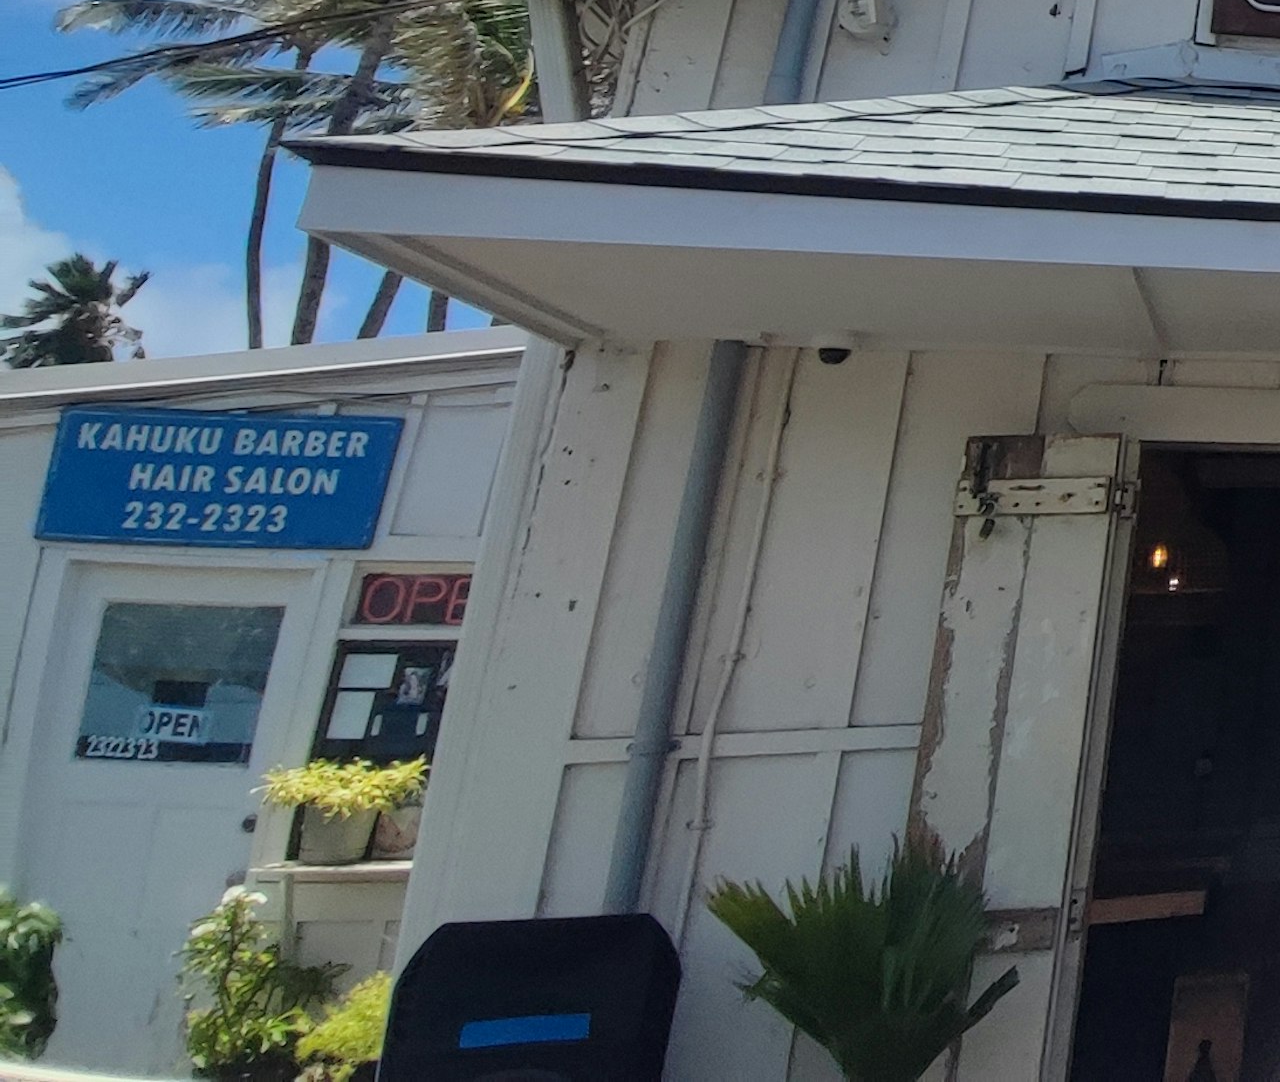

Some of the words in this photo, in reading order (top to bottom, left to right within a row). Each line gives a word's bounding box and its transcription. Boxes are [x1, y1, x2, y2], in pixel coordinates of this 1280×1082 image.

[77, 422, 225, 455] KAHUKU
[233, 428, 370, 458] BARBER
[128, 463, 215, 494] HAIR
[223, 465, 341, 496] SALON
[121, 500, 289, 533] 232-2323
[362, 576, 471, 625] OPE
[143, 710, 208, 738] OPEN
